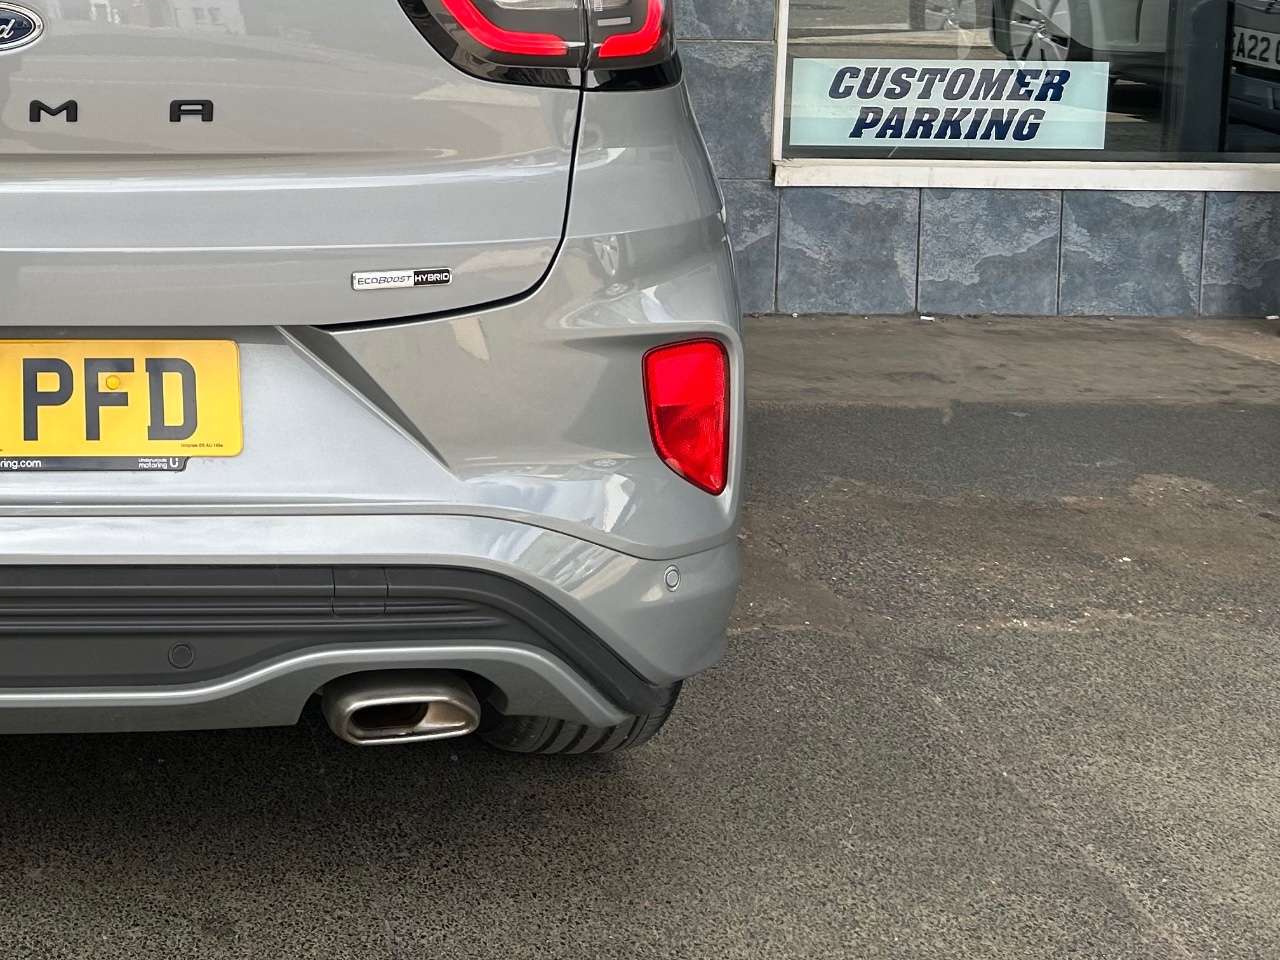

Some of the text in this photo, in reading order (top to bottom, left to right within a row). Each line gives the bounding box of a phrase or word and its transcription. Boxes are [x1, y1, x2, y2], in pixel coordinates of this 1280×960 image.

[1232, 30, 1271, 63] A22
[828, 66, 1071, 102] CUSTOMER
[848, 106, 1047, 141] PARKING
[414, 272, 450, 283] HYBRID
[22, 357, 199, 443] PFD
